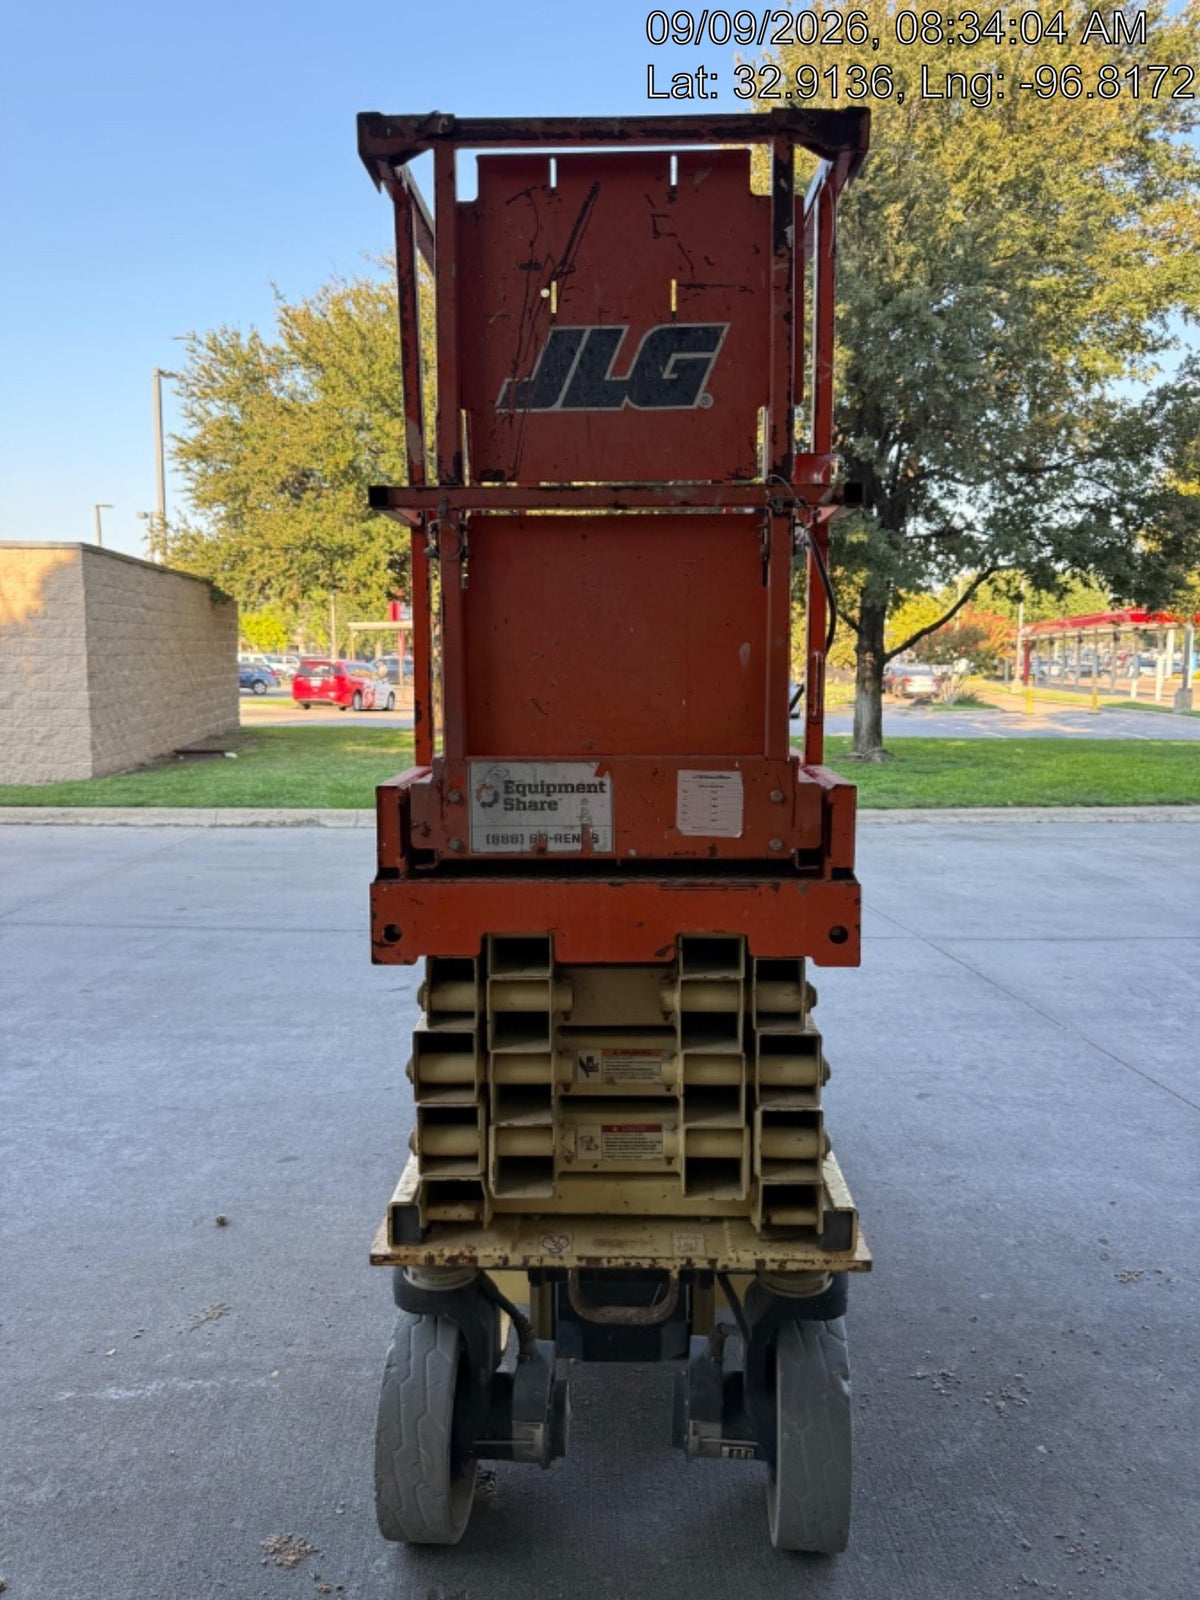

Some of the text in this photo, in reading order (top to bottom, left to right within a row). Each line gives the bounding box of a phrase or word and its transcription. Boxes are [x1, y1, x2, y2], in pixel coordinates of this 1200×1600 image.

[495, 321, 731, 412] JLG
[503, 780, 607, 796] Equipment
[503, 798, 559, 812] Share
[486, 833, 600, 845] (888) 8-RENS
